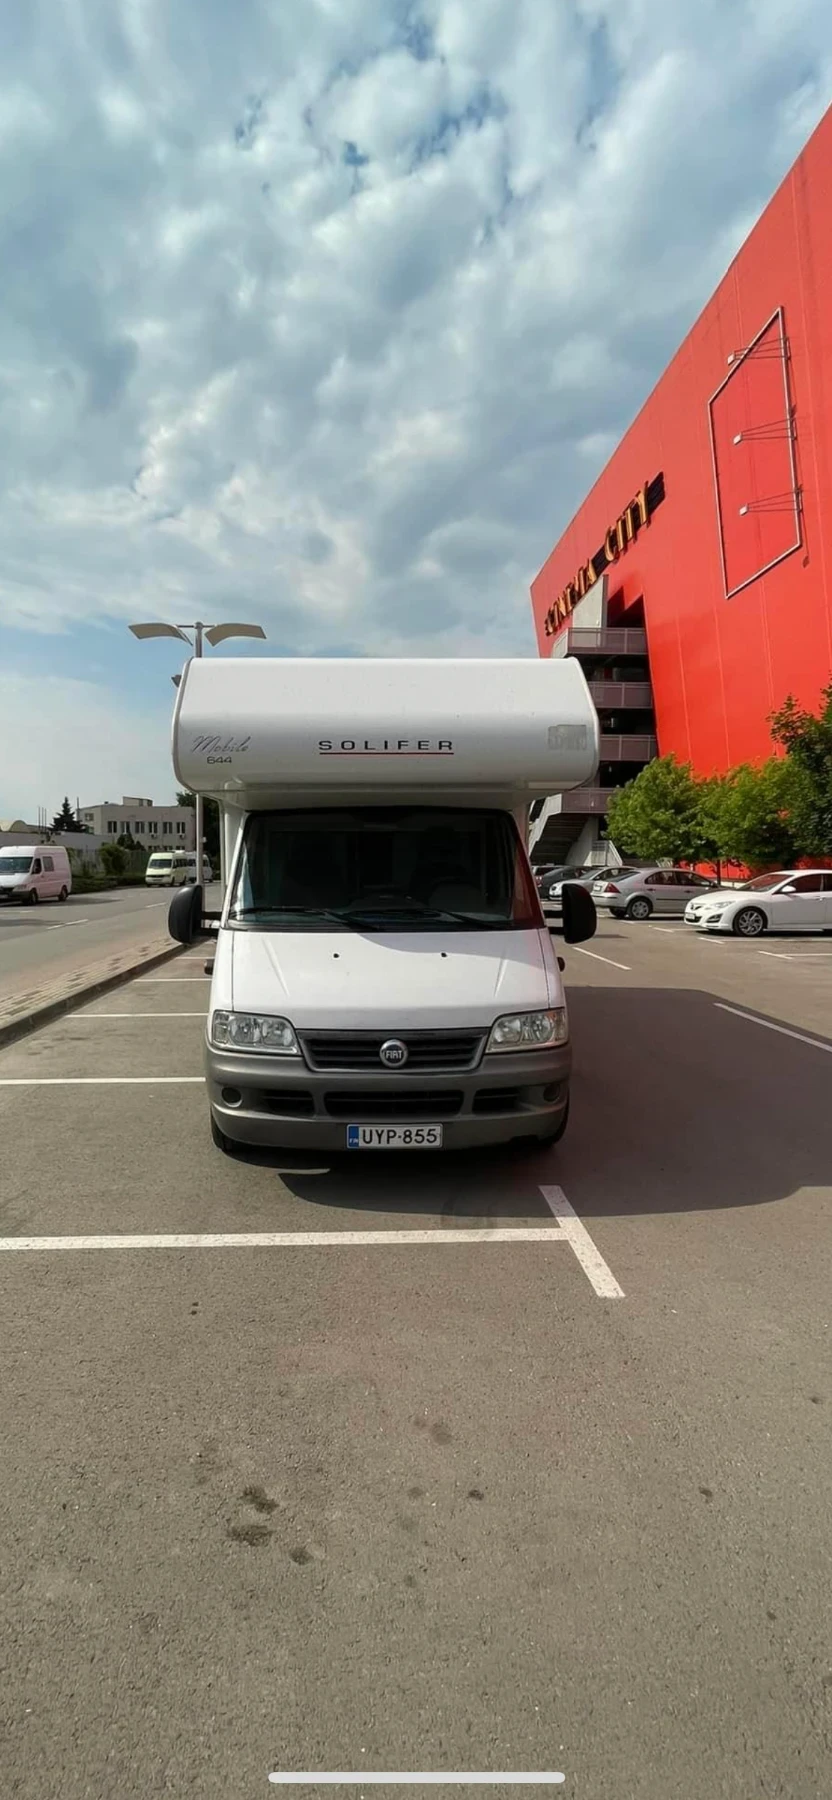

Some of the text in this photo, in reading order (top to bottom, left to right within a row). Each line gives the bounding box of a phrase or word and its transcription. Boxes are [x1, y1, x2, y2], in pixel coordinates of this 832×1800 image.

[604, 481, 651, 562] CITY
[191, 735, 251, 754] Mobile
[318, 740, 453, 750] SOLIFER
[206, 756, 232, 765] 644
[385, 1050, 403, 1059] FIAT
[362, 1128, 437, 1145] UYP-855
